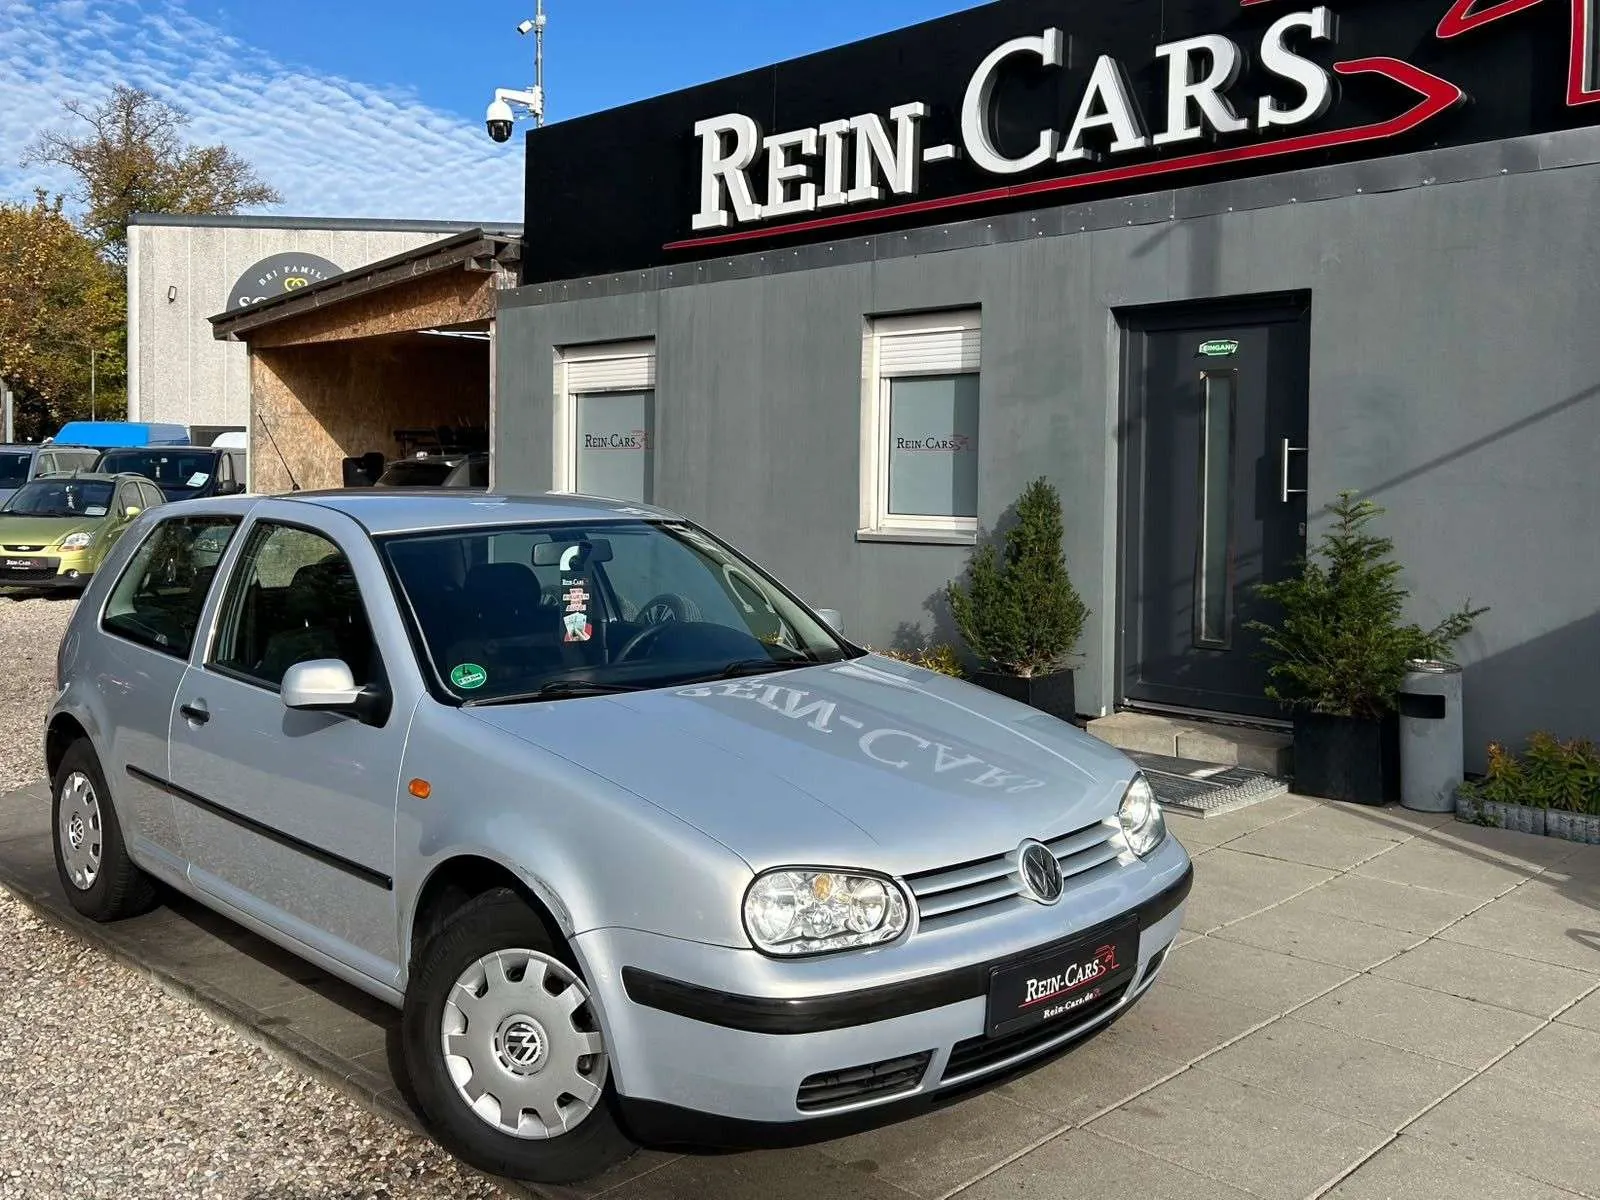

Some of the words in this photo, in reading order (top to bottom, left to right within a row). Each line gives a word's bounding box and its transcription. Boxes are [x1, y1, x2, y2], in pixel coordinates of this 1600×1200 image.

[692, 7, 1332, 230] REIN-CARS
[584, 433, 636, 448] REIN-CARS
[896, 437, 954, 449] REIN-CARS
[1025, 958, 1100, 1003] REIN-CARS
